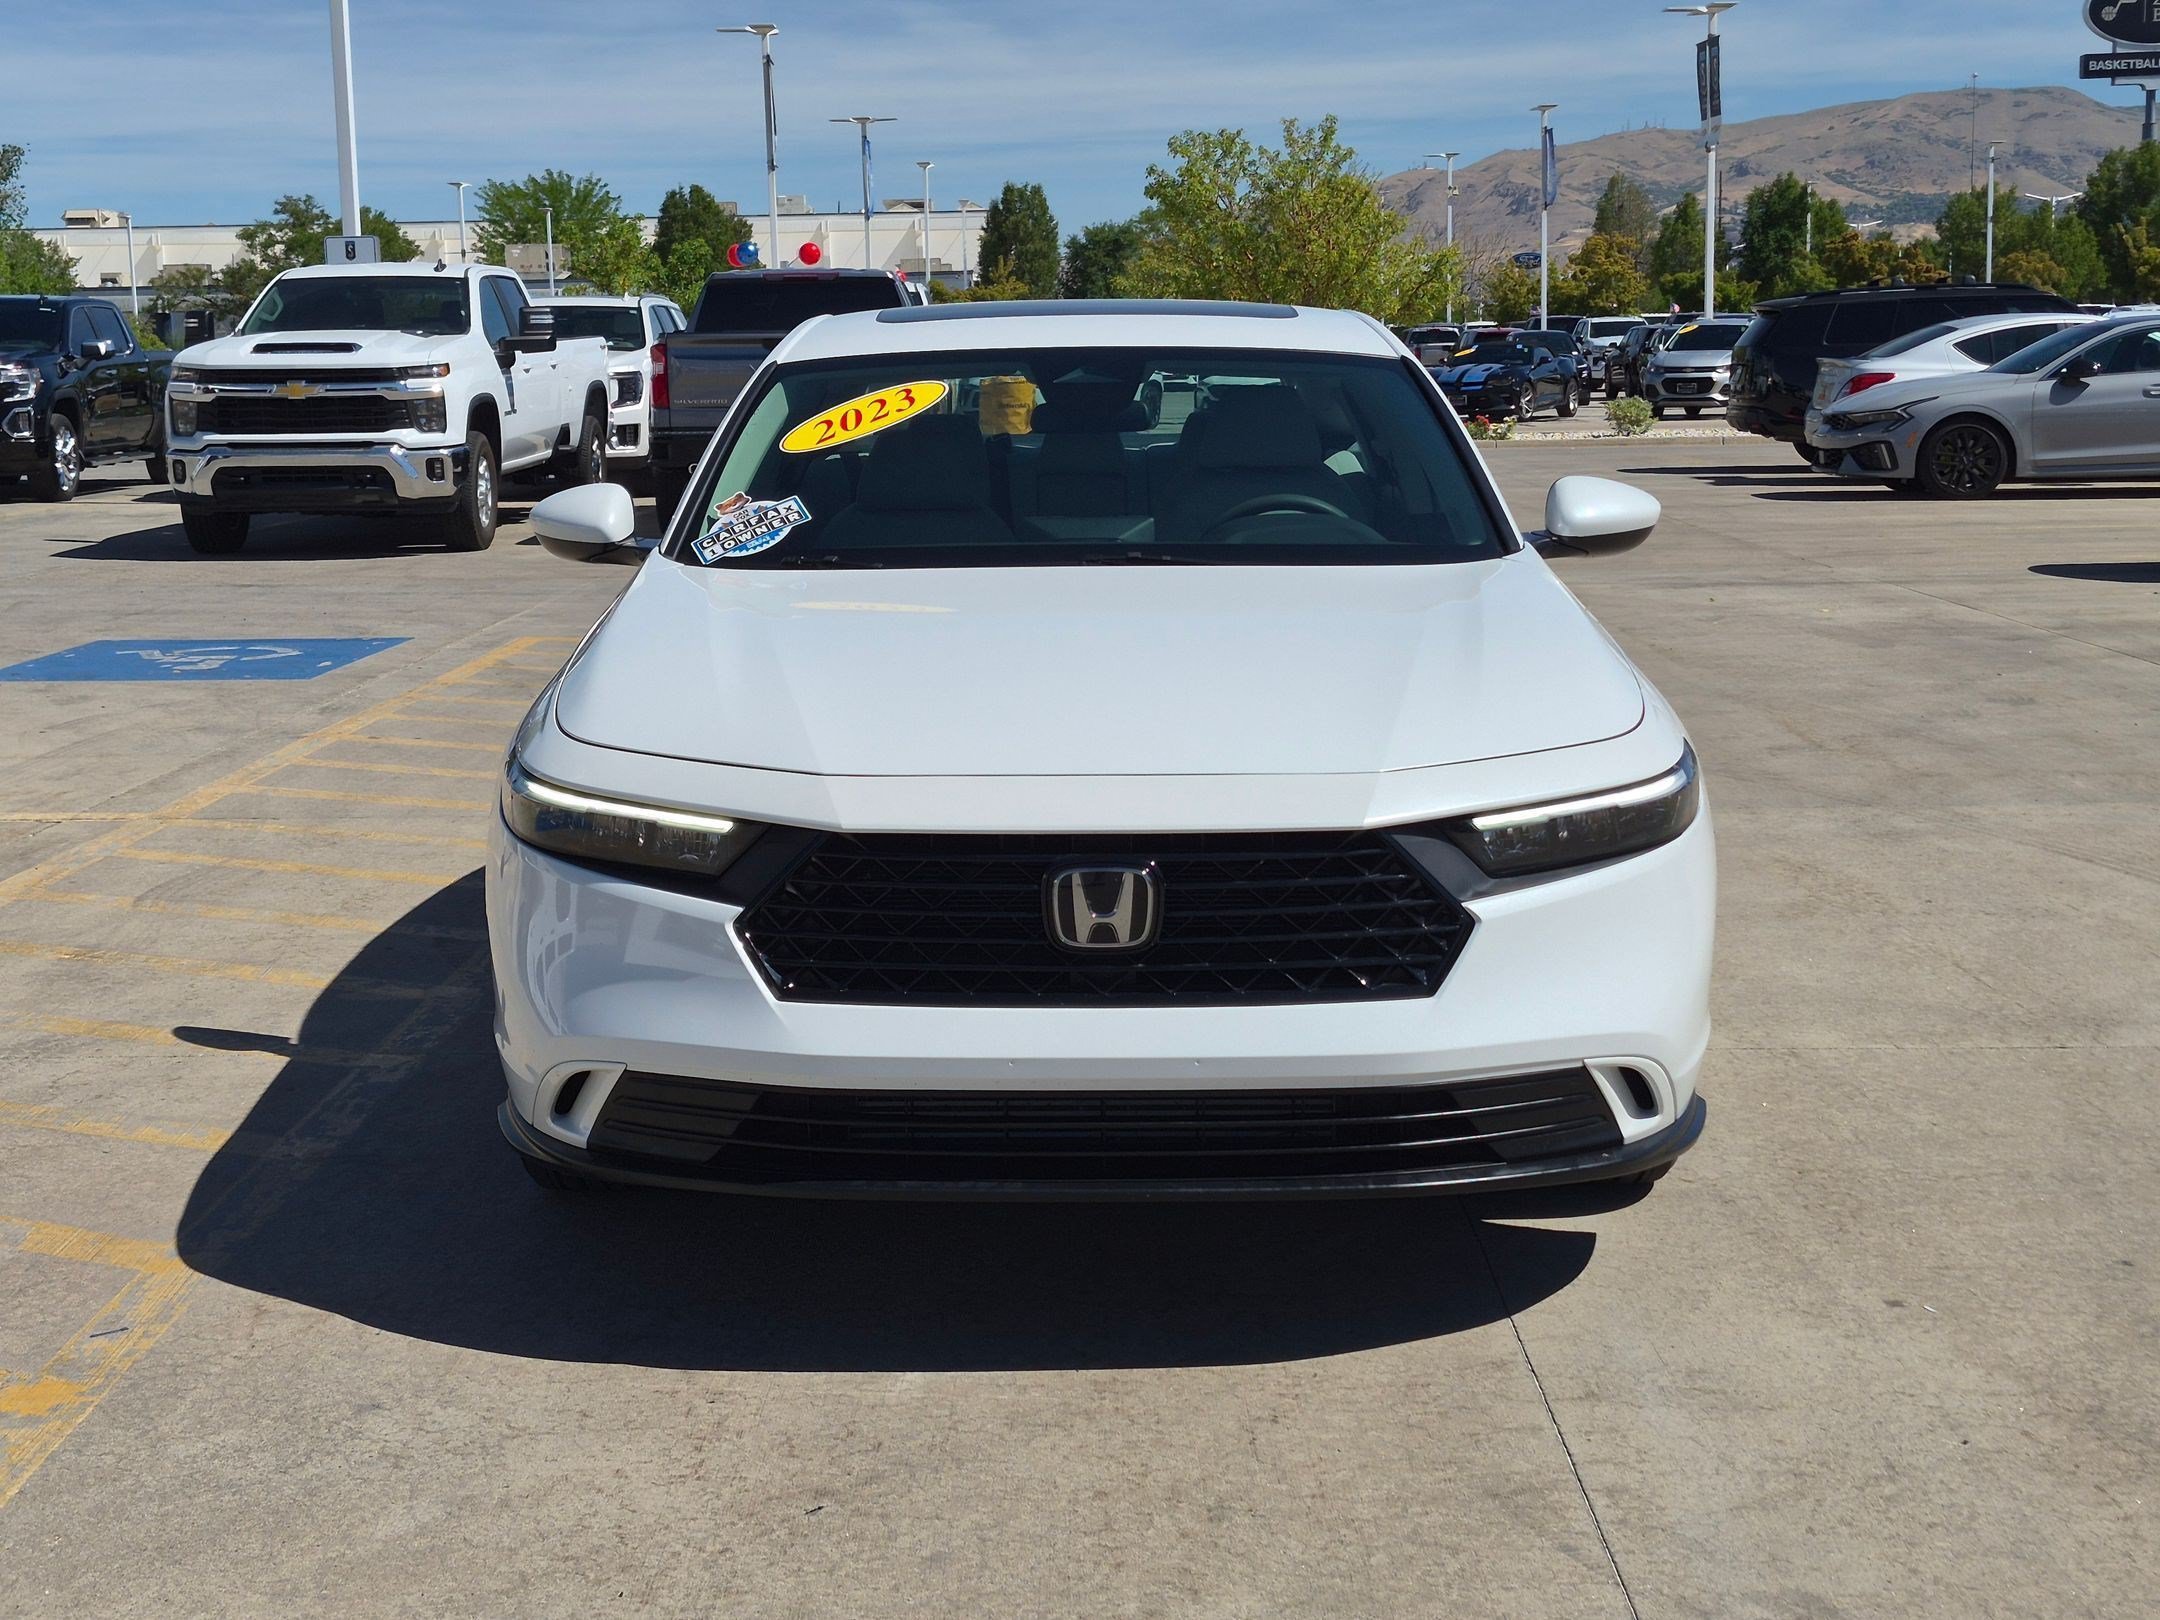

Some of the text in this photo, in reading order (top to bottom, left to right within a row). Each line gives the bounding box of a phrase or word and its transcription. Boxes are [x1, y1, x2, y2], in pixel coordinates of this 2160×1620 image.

[2089, 58, 2160, 71] BASKETBAL
[813, 388, 916, 445] 2023
[702, 505, 794, 548] CARFAX
[723, 512, 801, 549] OWNER
